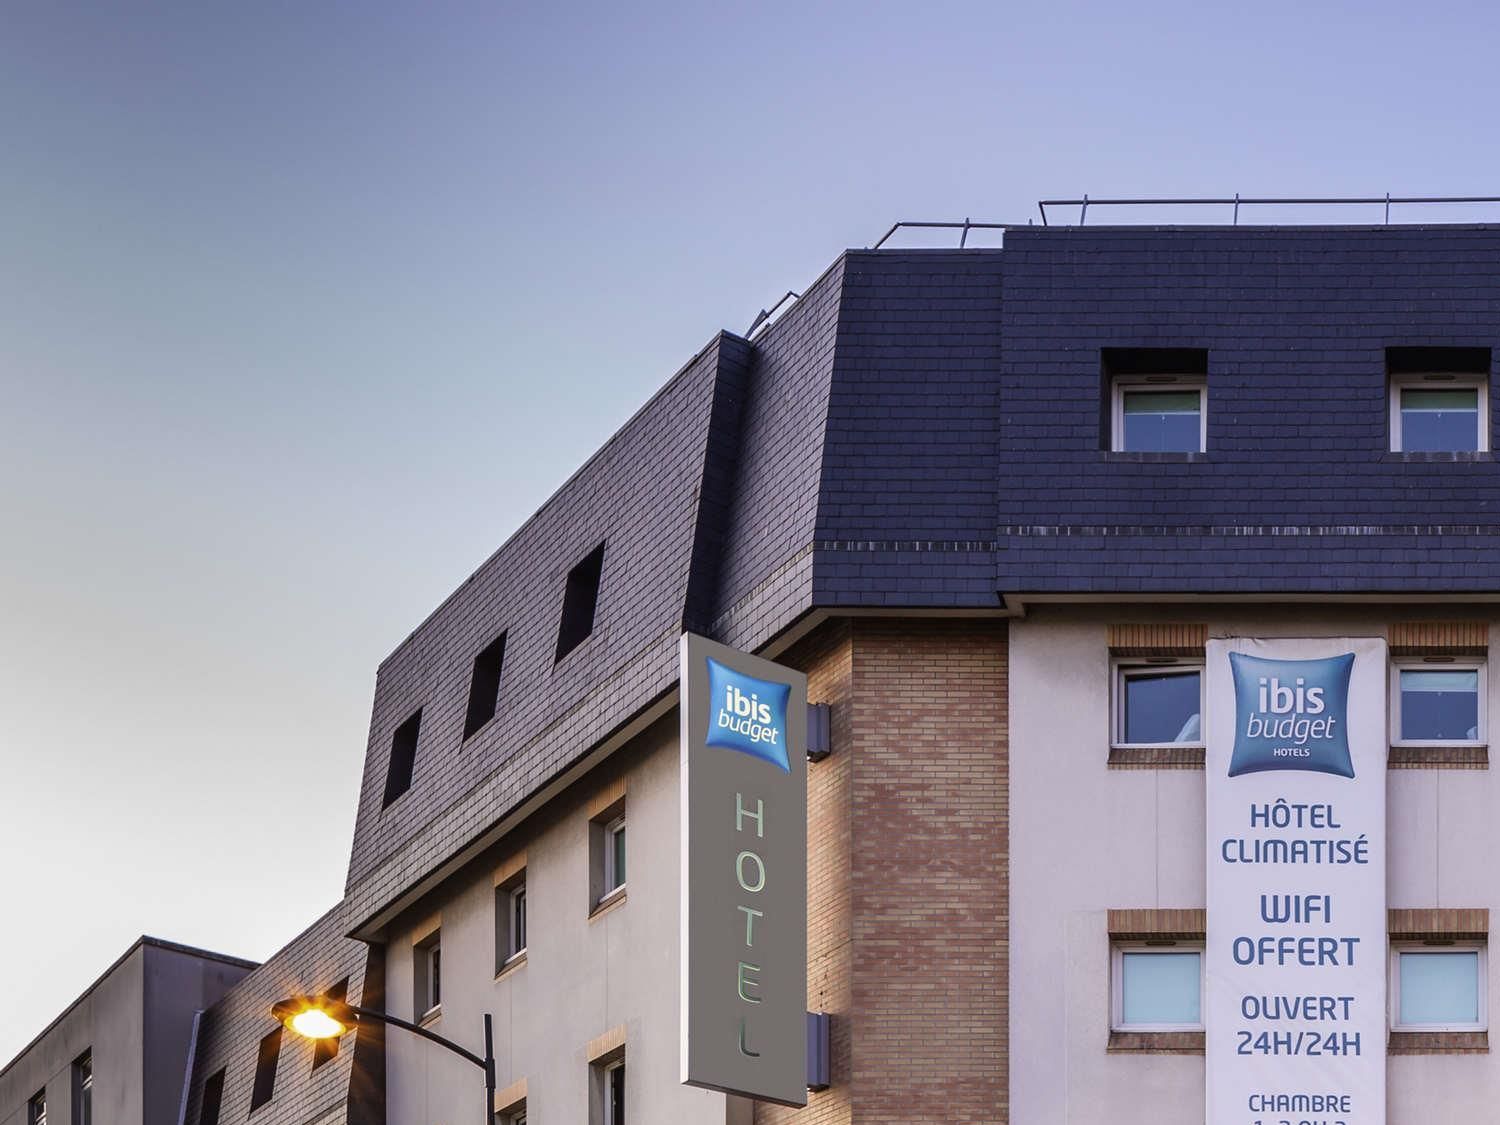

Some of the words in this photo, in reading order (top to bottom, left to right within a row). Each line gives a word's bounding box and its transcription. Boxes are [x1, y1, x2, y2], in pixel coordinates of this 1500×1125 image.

[726, 685, 771, 724] ibis
[1259, 678, 1325, 714] ibis
[718, 708, 778, 744] budget
[1247, 712, 1336, 744] budget
[1273, 748, 1310, 757] HOTELS
[1251, 798, 1341, 828] HÔTEL
[1222, 834, 1368, 864] CLIMATISÉ
[1261, 895, 1331, 923] WIFI
[736, 792, 766, 1057] HOTEL
[1232, 936, 1360, 966] OFFERT
[1241, 995, 1354, 1020] OUVERT
[1237, 1031, 1361, 1056] 24H/24H
[1249, 1095, 1351, 1112] CHAMBRE
